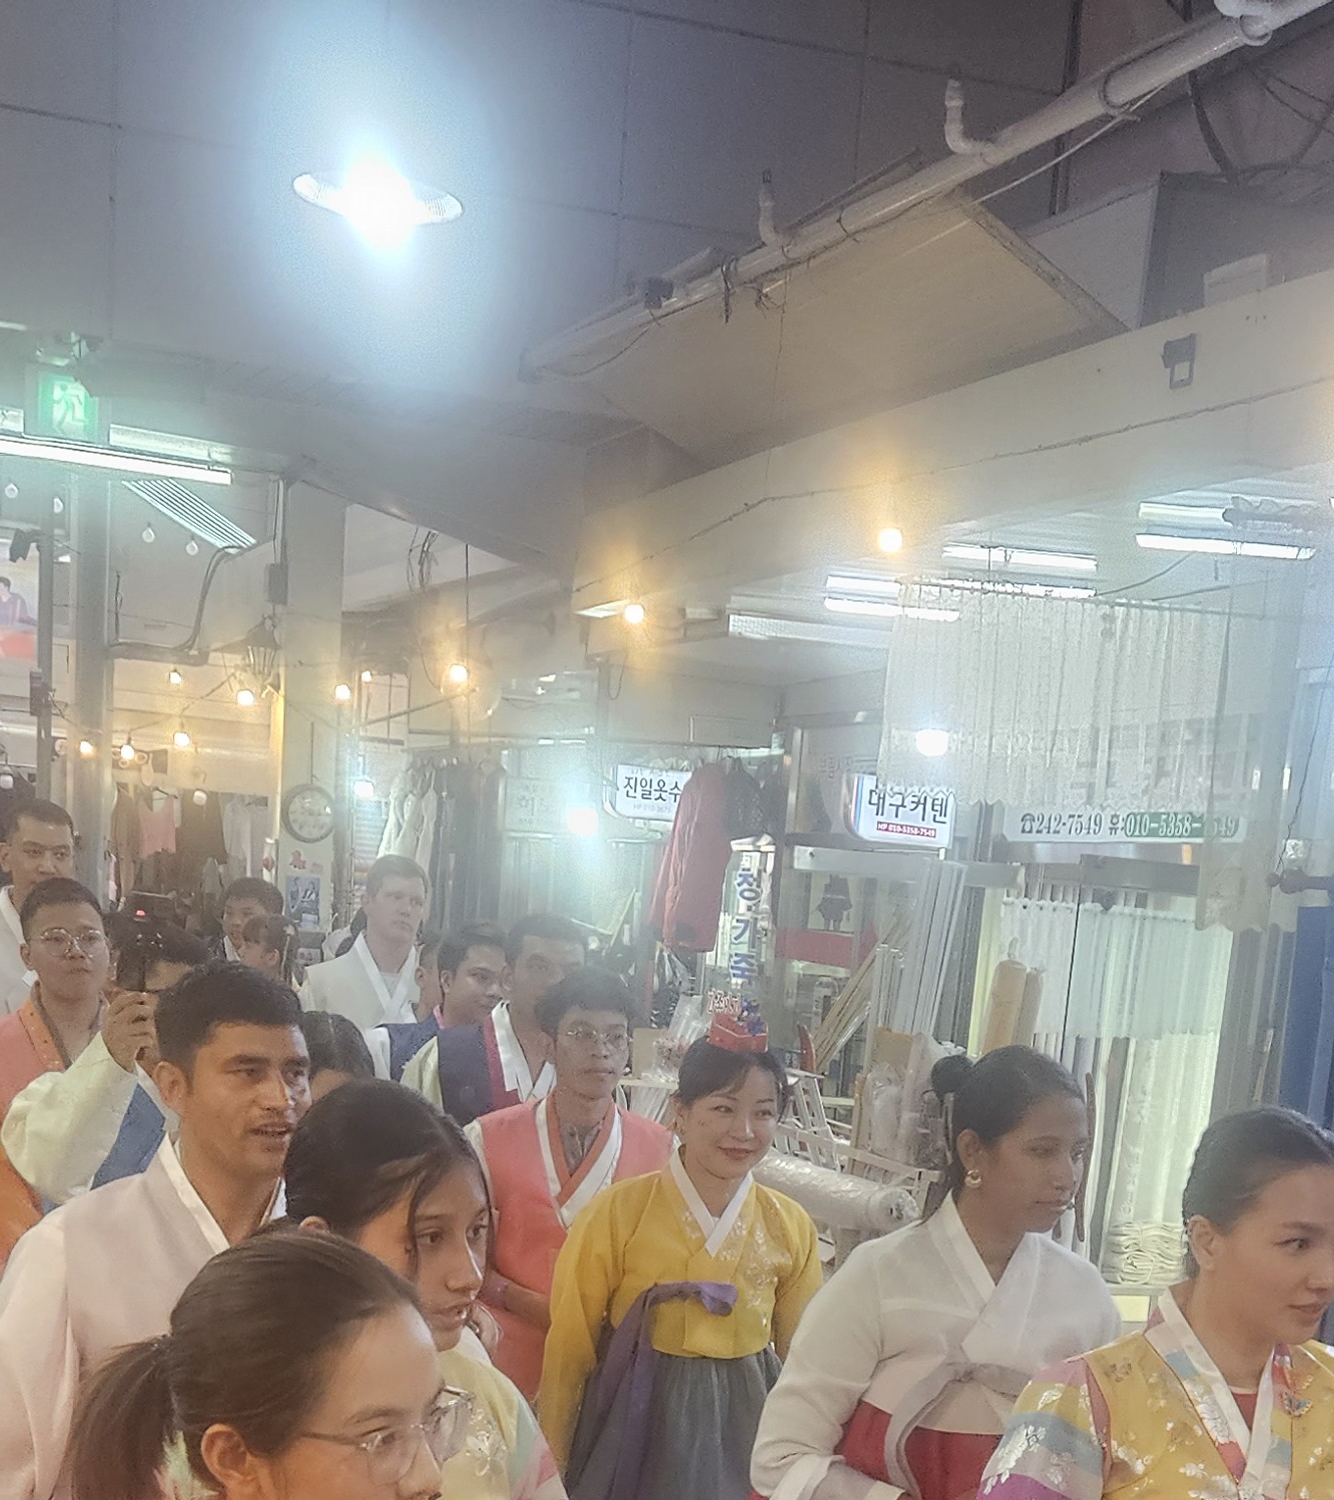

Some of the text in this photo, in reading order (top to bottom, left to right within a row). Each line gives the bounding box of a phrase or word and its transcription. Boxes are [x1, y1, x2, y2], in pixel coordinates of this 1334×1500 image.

[868, 788, 947, 824] 대구커텐
[1035, 812, 1103, 836] 242-7549
[1126, 811, 1237, 837] 010-5358-549
